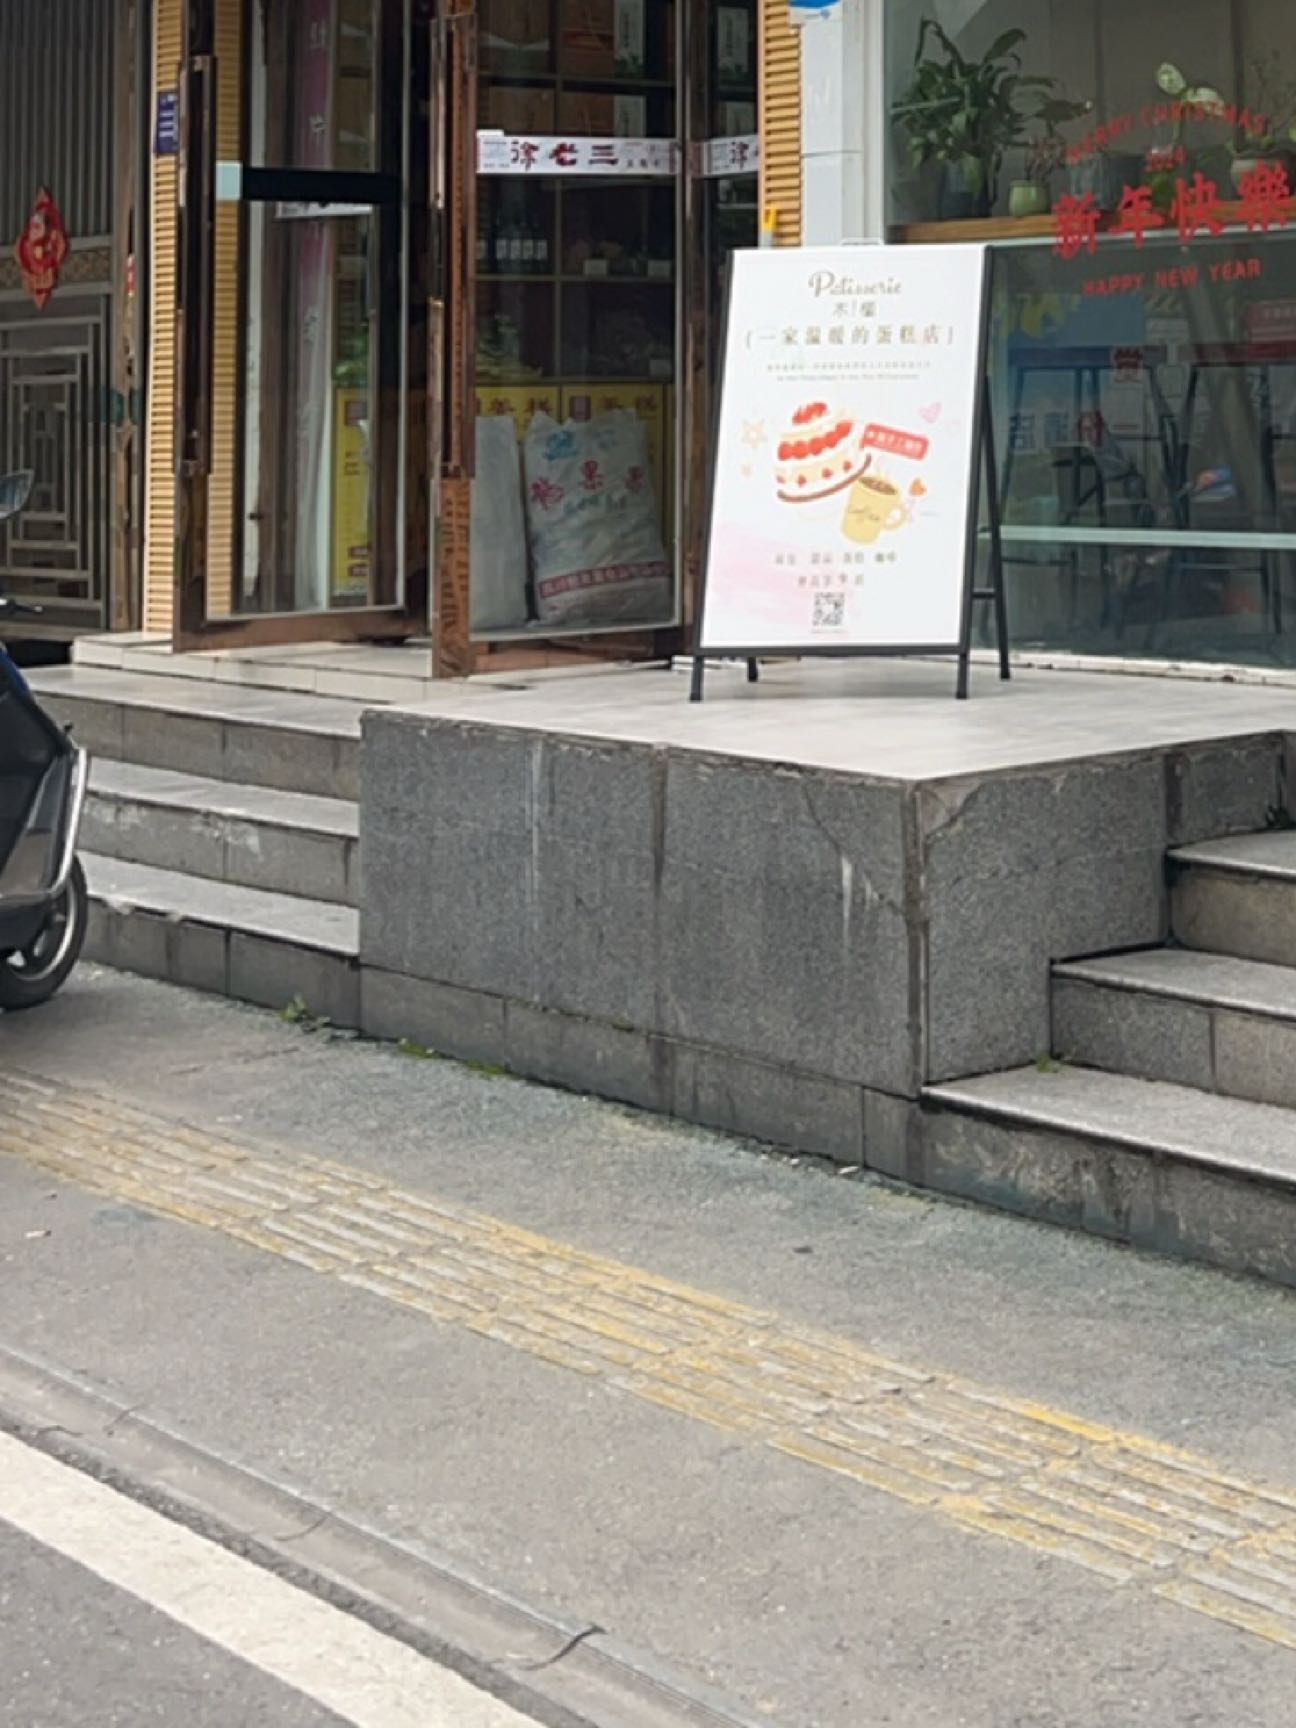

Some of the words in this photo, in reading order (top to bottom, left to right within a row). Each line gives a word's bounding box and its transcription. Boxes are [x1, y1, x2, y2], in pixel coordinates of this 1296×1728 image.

[1082, 273, 1145, 297] HAPPY
[1157, 268, 1198, 288] NEW
[1209, 259, 1262, 280] YEAR
